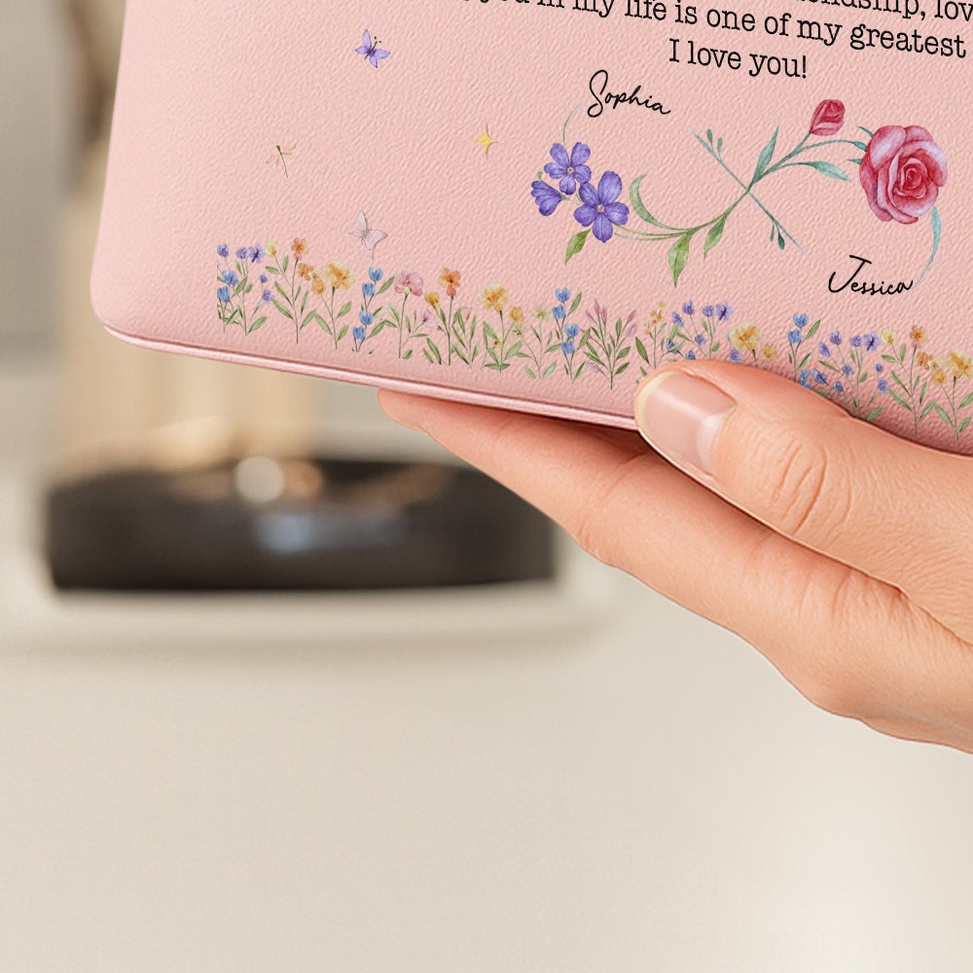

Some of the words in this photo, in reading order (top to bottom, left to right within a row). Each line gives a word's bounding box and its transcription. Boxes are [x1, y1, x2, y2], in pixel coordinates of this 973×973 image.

[706, 8, 756, 32] one
[764, 12, 792, 37] of
[796, 19, 843, 47] my
[849, 23, 967, 59] greatest
[669, 37, 680, 63] I
[687, 40, 742, 71] love
[748, 53, 807, 79] you!
[586, 69, 672, 118] Sophia
[827, 254, 914, 296] Jessica
